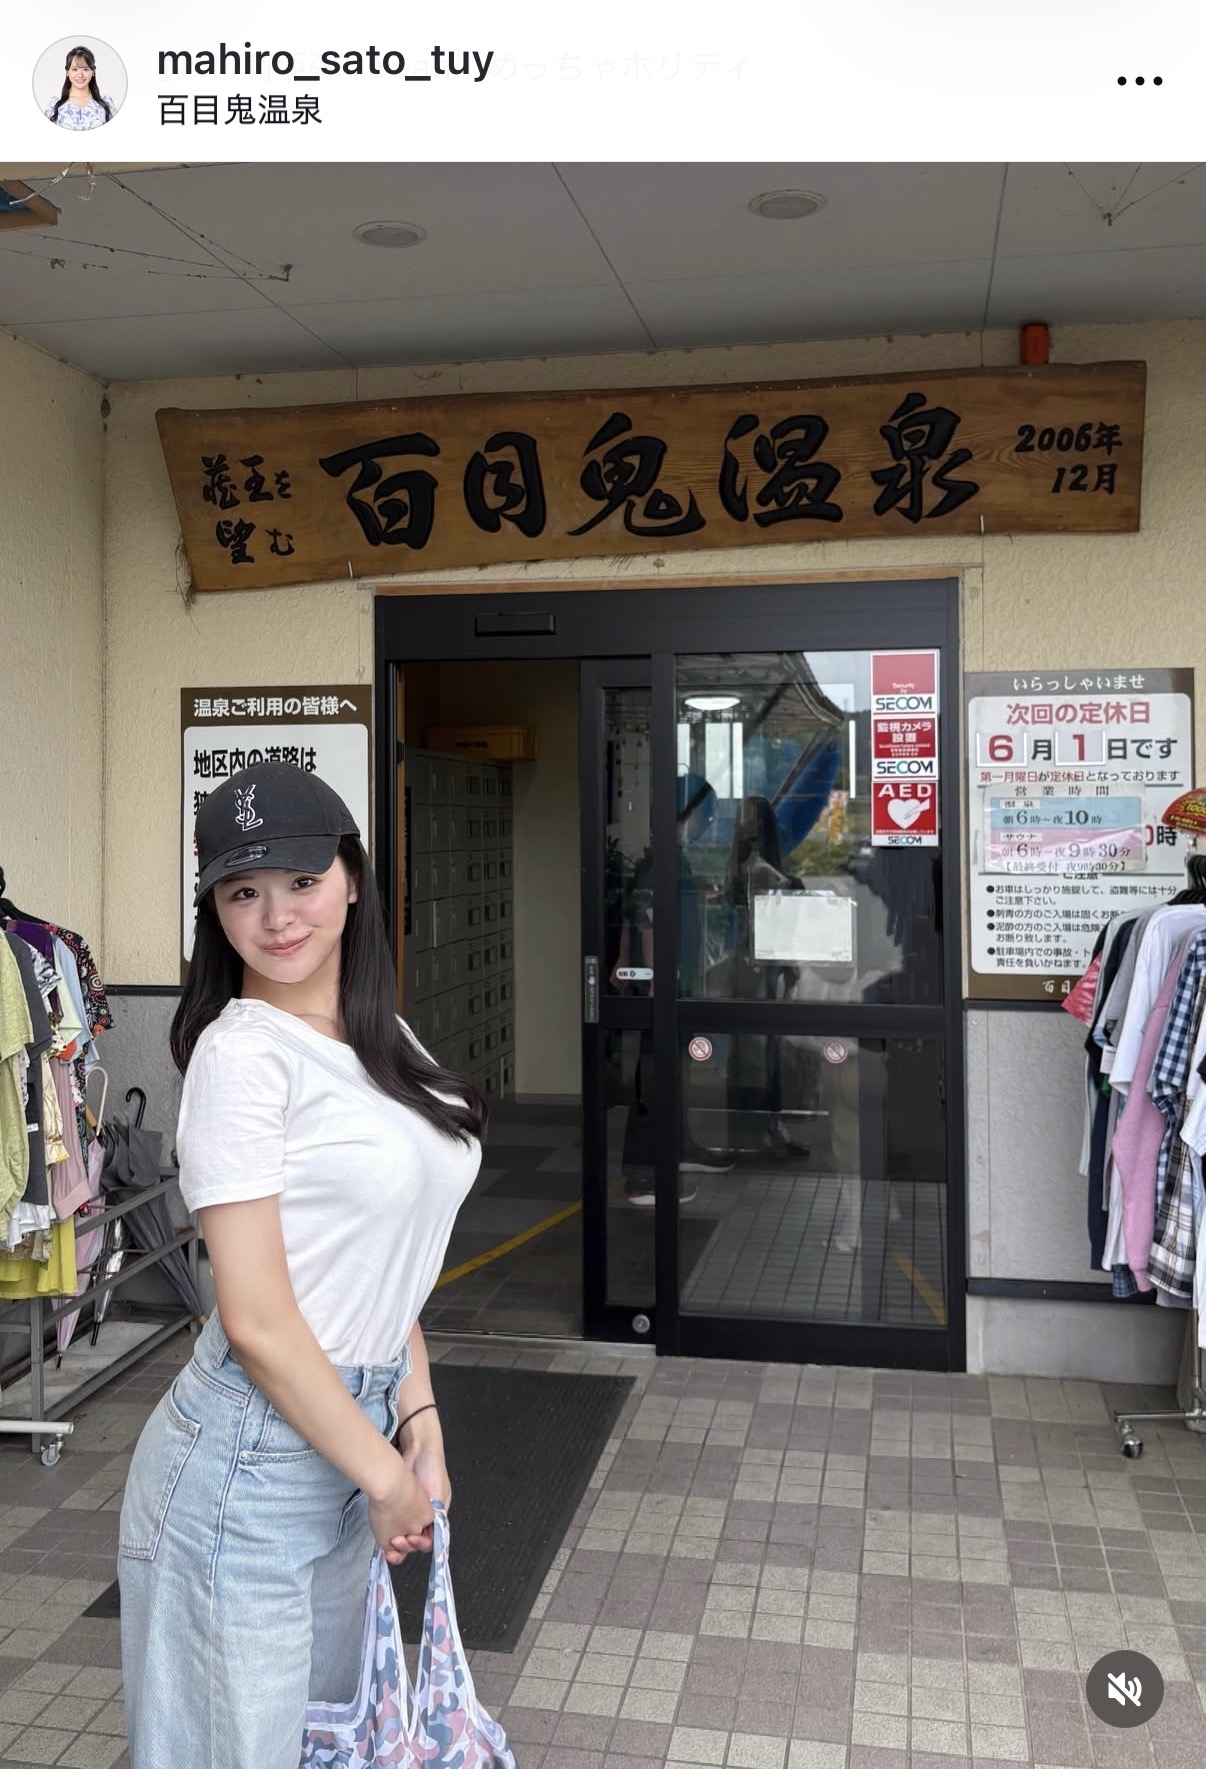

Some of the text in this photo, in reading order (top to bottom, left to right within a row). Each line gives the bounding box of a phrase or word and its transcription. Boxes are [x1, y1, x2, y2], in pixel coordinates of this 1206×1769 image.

[1014, 421, 1123, 456] 2006年
[318, 391, 981, 550] 百目鬼温泉
[1050, 463, 1118, 496] 12月
[1013, 674, 1145, 691] いらっしゃいませ
[193, 696, 358, 718] 温泉ご利用の皆様へ
[875, 696, 932, 710] SECOM
[1006, 701, 1150, 726] 次回の定休日
[877, 722, 933, 733] 監視カメラ
[892, 733, 917, 744] 設置
[877, 760, 933, 775] SECOM
[980, 770, 1180, 783] 第一月曜日が定休日となっております
[878, 783, 933, 799] AED
[888, 835, 922, 845] SECOM
